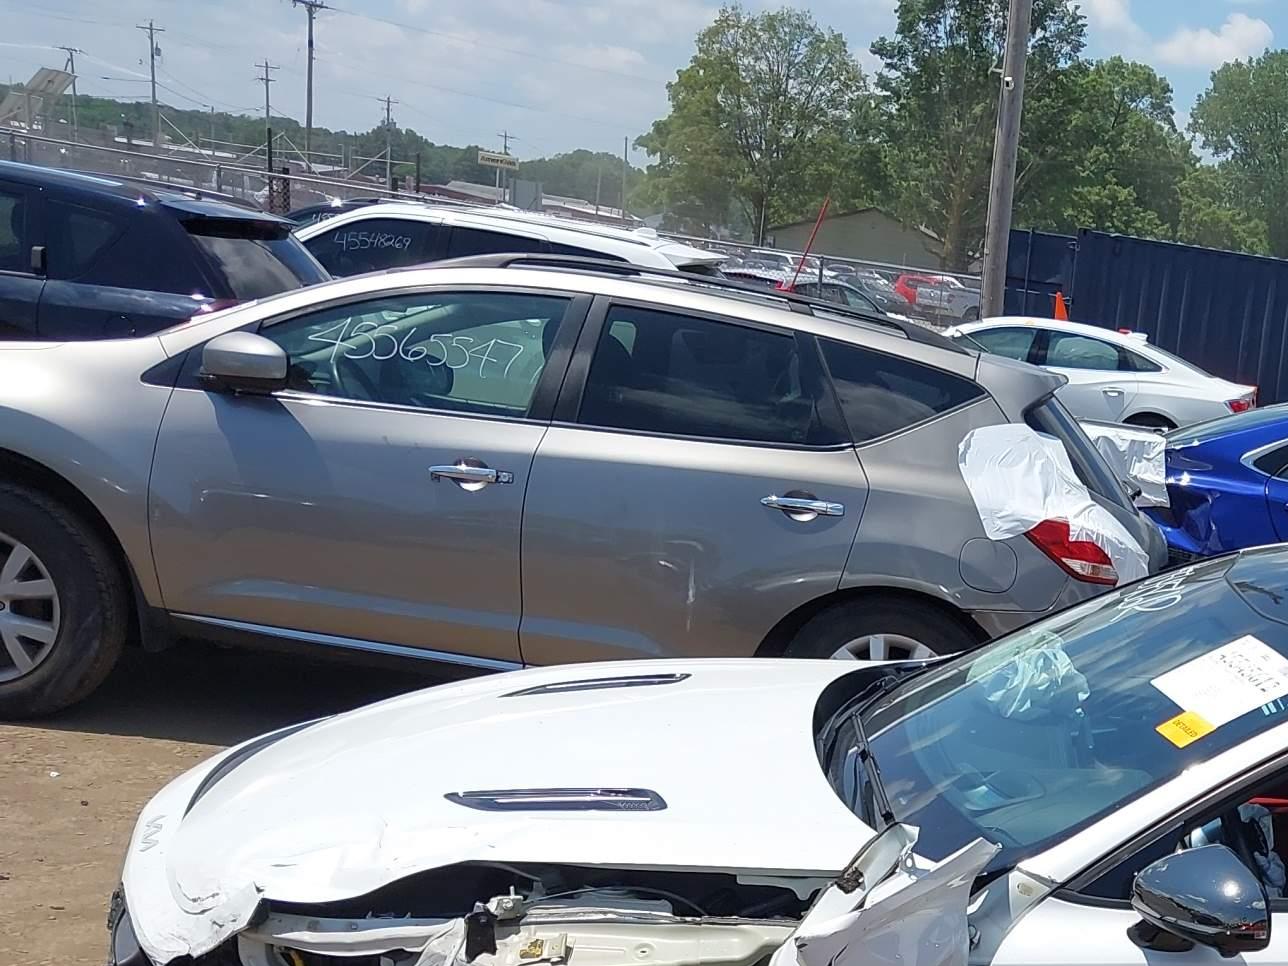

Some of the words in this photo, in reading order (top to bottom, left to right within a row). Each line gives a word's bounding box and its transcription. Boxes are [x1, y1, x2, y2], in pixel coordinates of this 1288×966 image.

[333, 231, 412, 252] 45548269
[307, 316, 525, 380] 45565547
[1172, 719, 1198, 738] DETAILED
